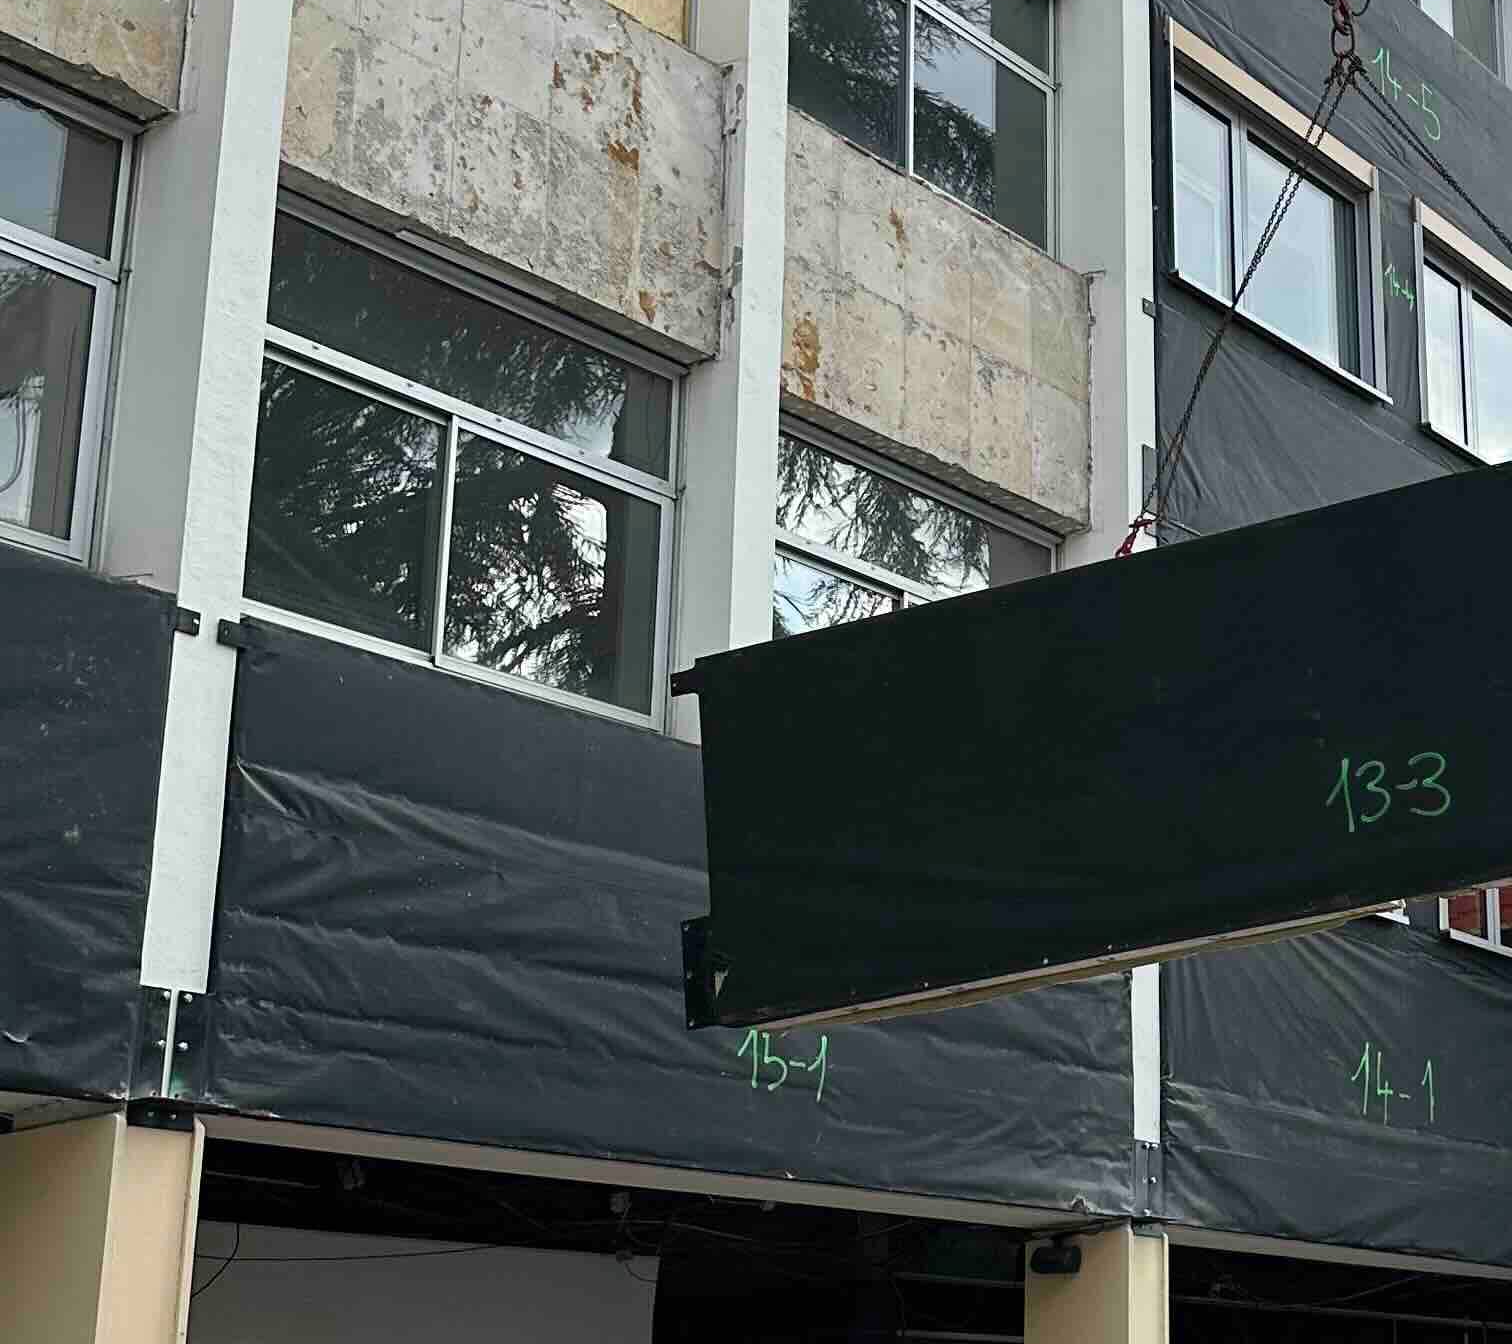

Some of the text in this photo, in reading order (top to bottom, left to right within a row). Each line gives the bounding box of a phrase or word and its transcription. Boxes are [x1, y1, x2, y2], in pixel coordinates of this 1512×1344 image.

[1371, 47, 1441, 141] 14-5
[1325, 752, 1451, 833] 13-3
[737, 1029, 828, 1103] 15-1
[1351, 1042, 1436, 1127] 14-1
